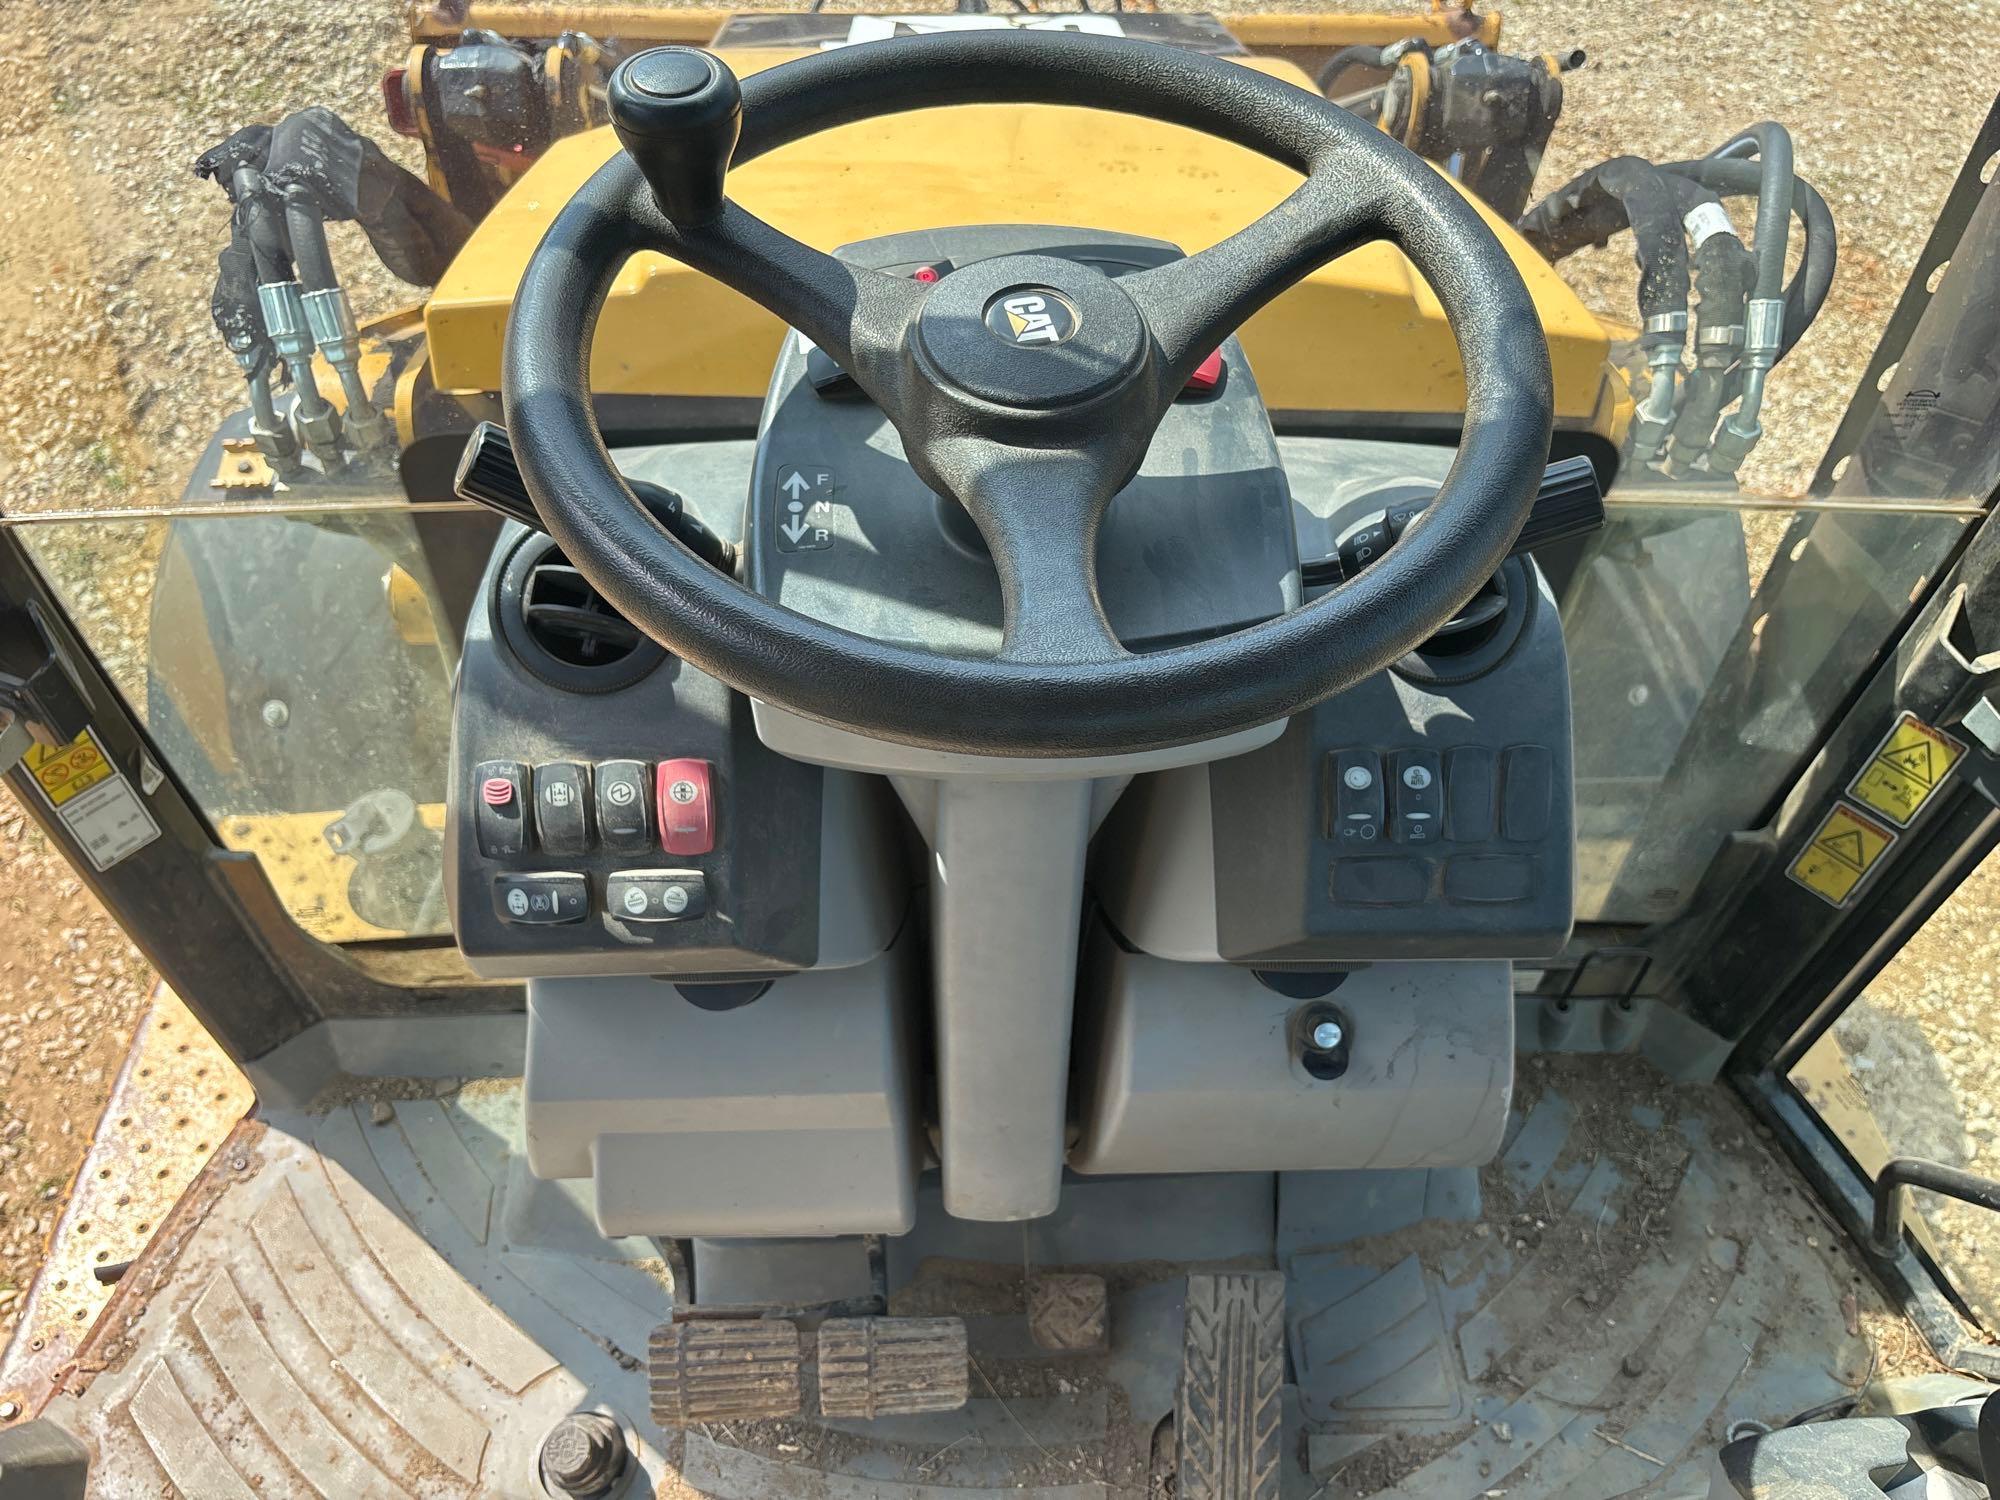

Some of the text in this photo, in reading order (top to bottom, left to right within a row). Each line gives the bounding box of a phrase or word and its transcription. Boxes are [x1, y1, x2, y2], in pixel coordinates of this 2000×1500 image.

[1003, 296, 1060, 342] CAT
[817, 473, 829, 485] F
[667, 501, 676, 513] 4
[815, 500, 830, 513] N
[815, 529, 829, 542] R
